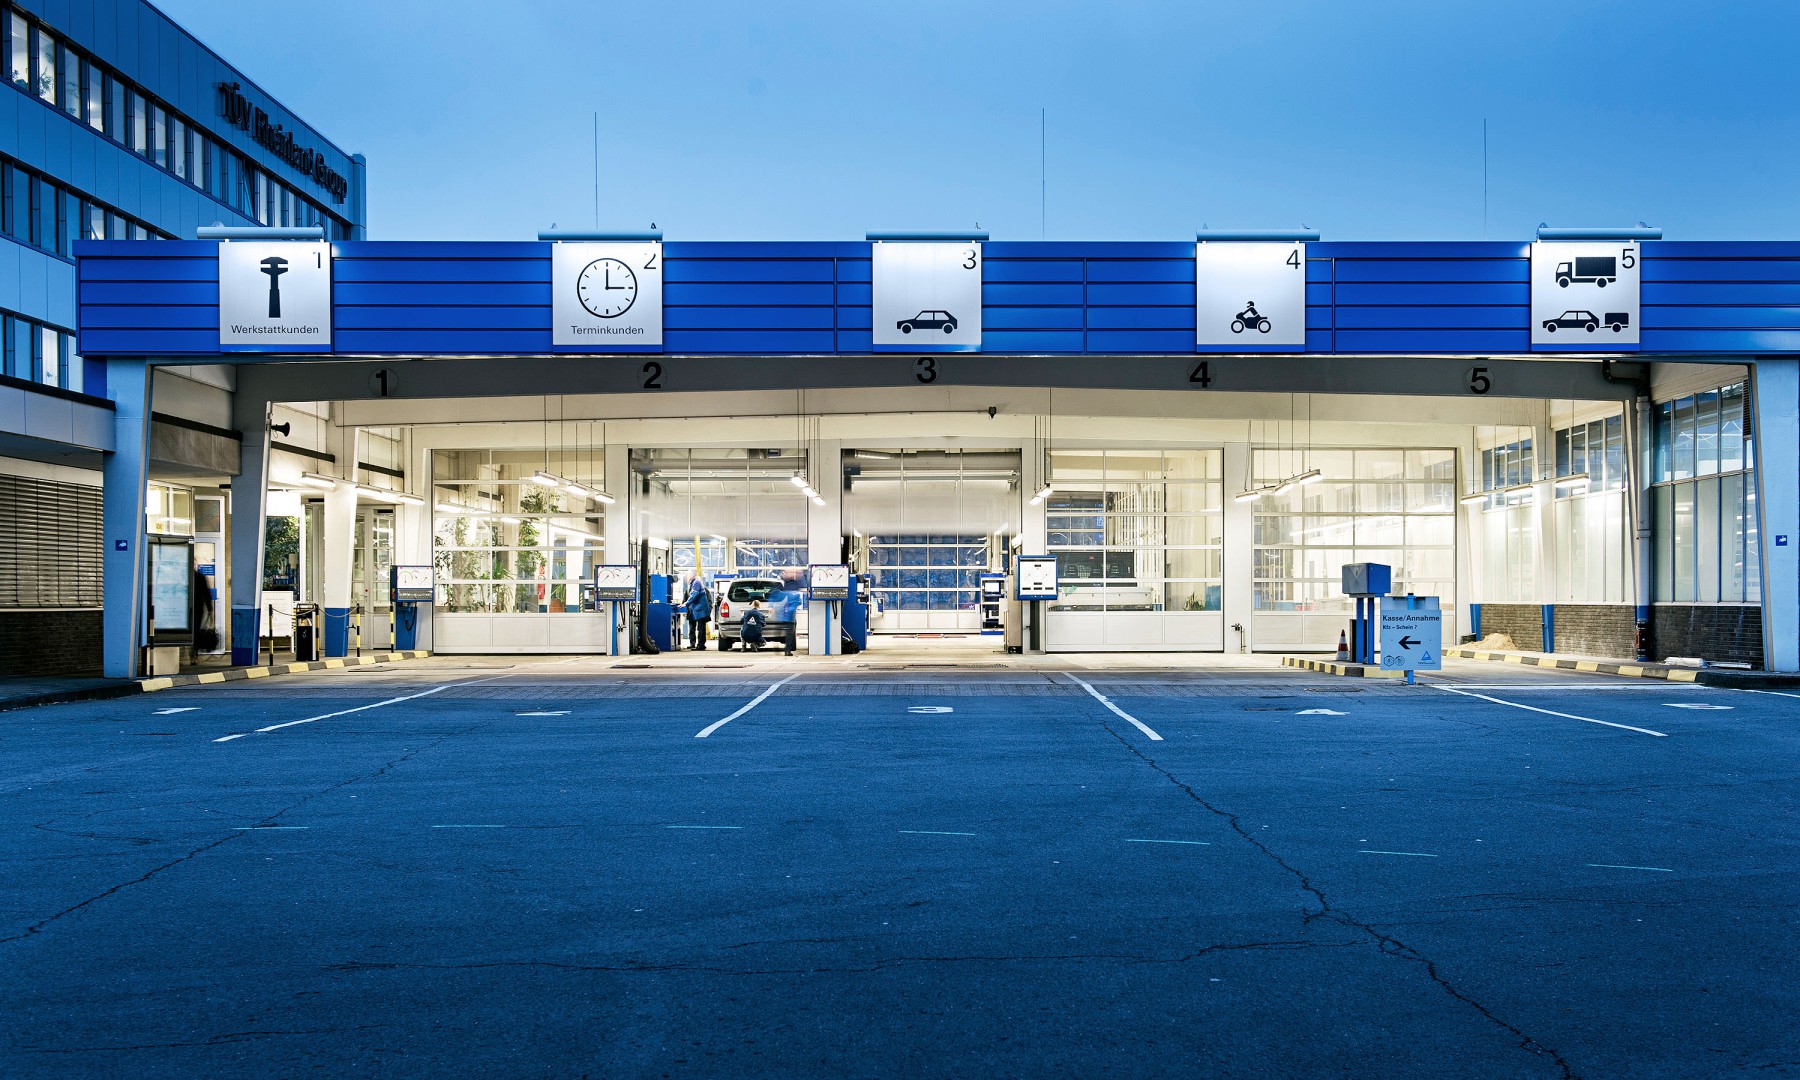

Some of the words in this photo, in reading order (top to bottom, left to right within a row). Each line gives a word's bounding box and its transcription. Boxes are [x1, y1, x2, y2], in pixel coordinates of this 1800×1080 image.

[216, 82, 252, 131] TÜV
[253, 107, 313, 174] Rheinland
[314, 153, 347, 203] Group
[313, 251, 320, 269] 1
[643, 252, 657, 269] 2
[962, 249, 977, 270] 3
[1286, 249, 1301, 269] 4
[1622, 248, 1635, 269] 5
[231, 325, 319, 334] Werkstattkunden
[571, 326, 644, 334] Terminkunden
[642, 361, 662, 389] 2
[917, 356, 937, 384] 3
[1190, 361, 1211, 388] 4
[1470, 367, 1490, 394] 5
[375, 369, 388, 397] 1
